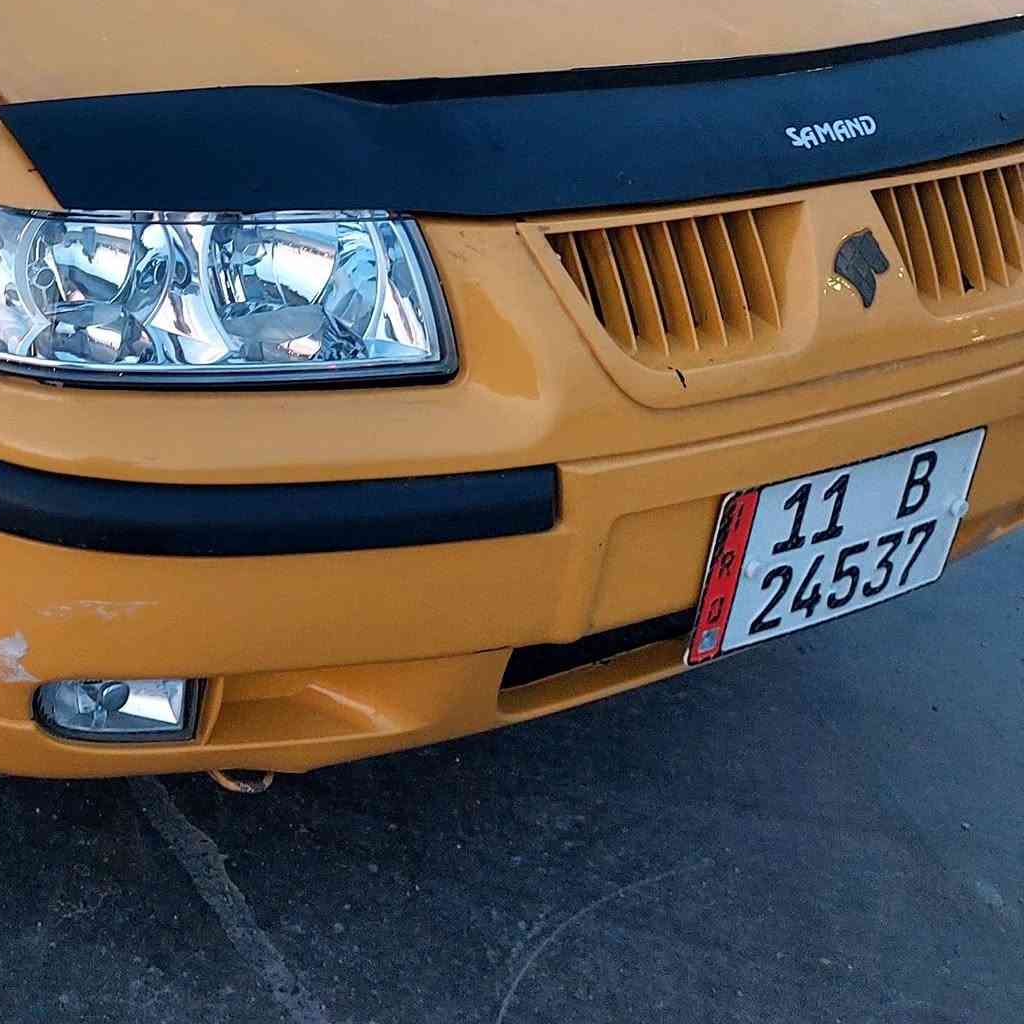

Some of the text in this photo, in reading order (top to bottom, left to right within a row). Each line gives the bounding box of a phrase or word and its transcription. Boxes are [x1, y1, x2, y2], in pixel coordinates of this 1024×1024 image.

[785, 115, 877, 149] SAMAND
[772, 449, 938, 555] 11 B
[748, 519, 937, 636] 24537
